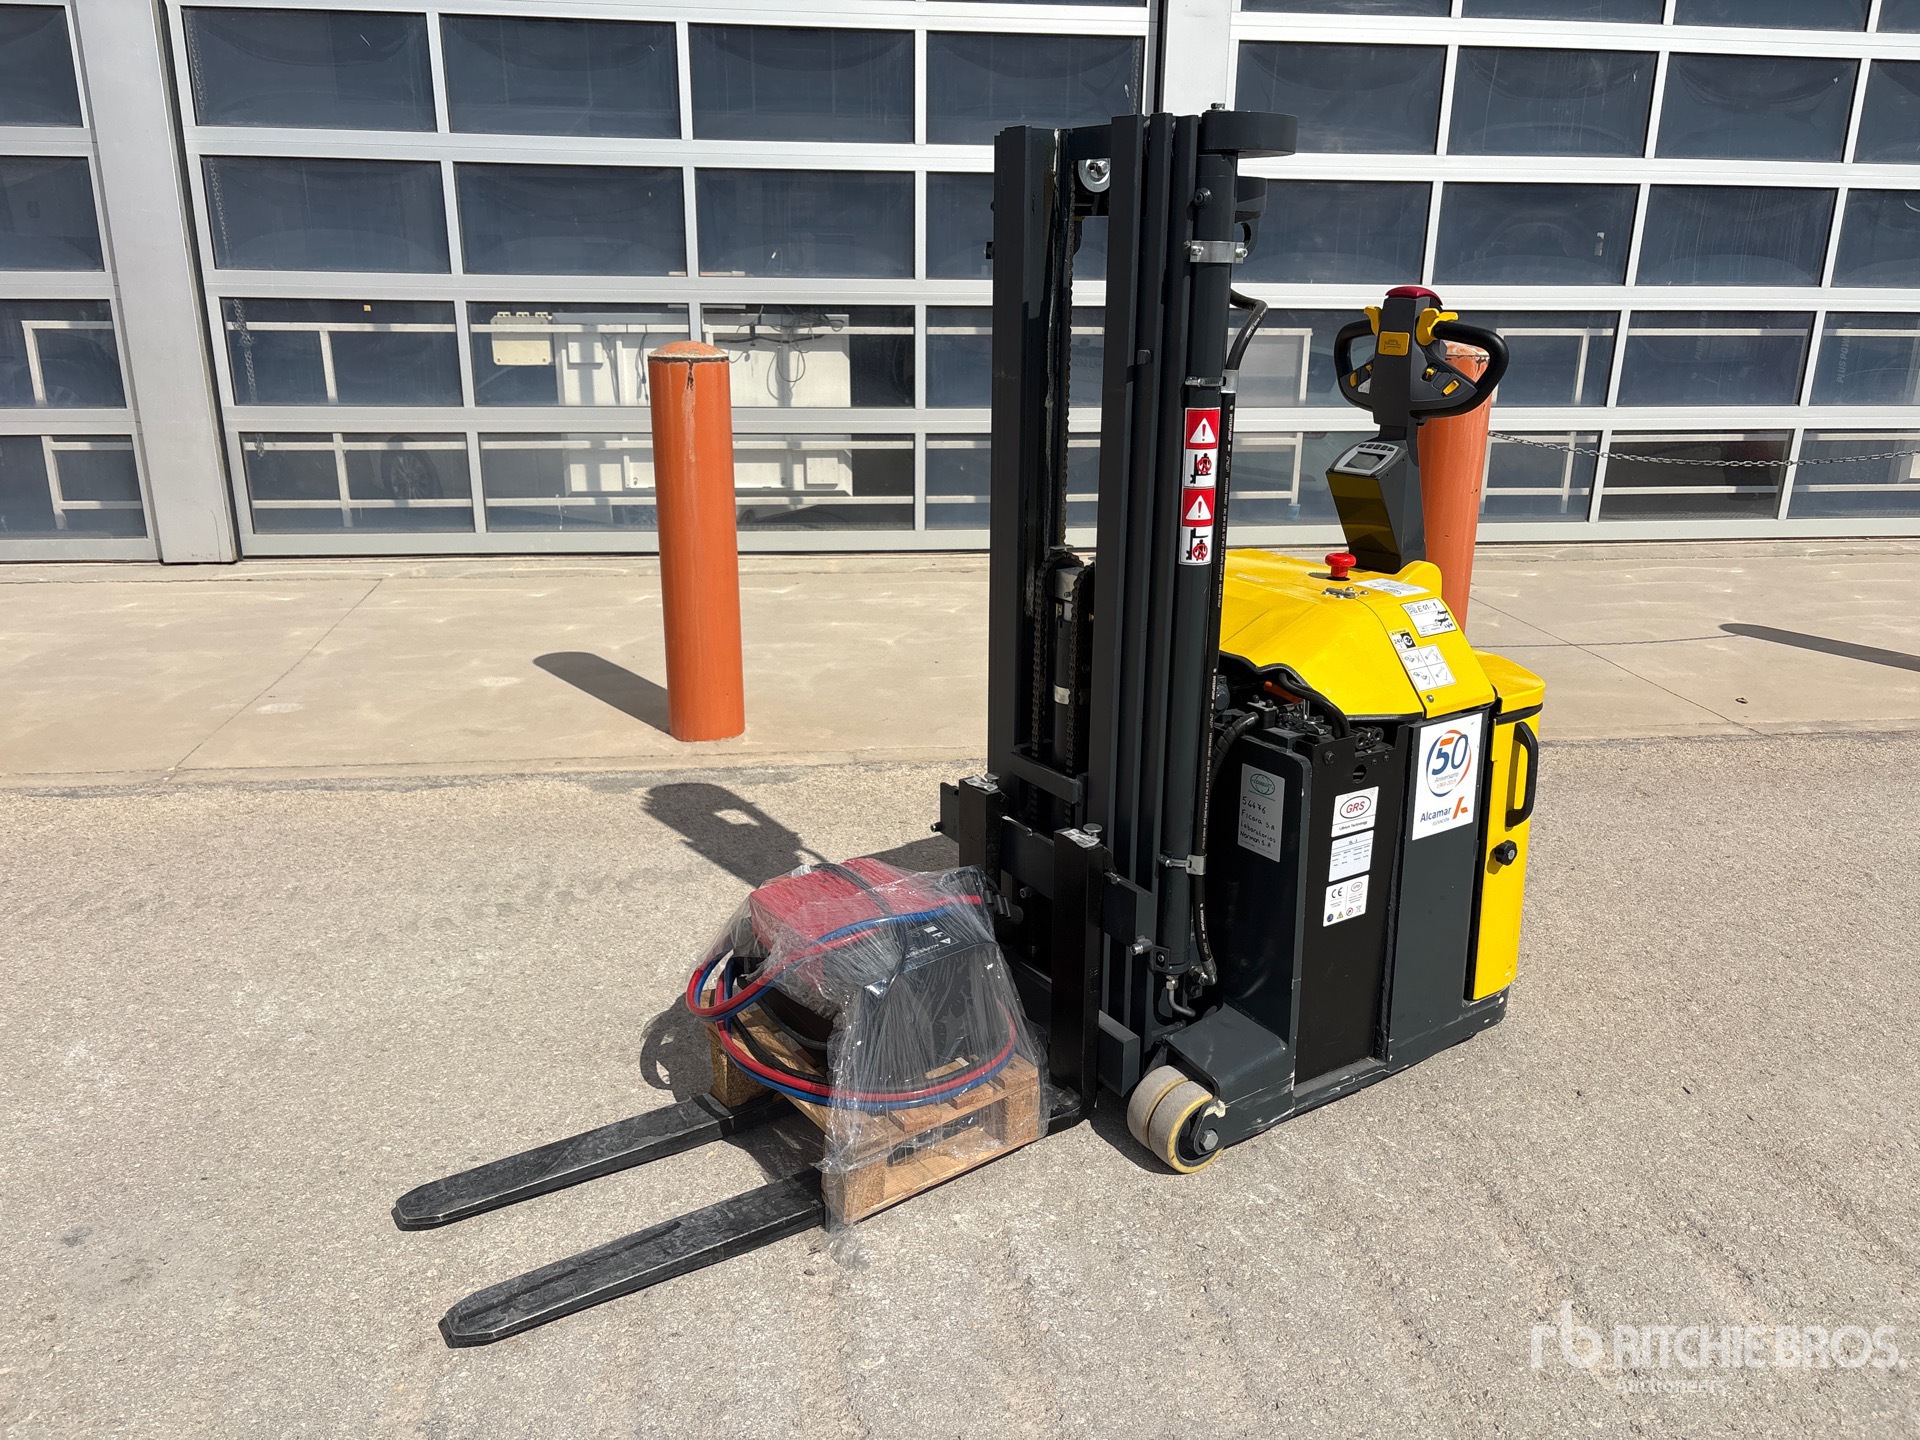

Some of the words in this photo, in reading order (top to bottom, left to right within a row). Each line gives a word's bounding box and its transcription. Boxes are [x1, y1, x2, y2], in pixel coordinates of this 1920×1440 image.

[1836, 360, 1847, 384] PLUS
[1431, 733, 1469, 776] 50
[1346, 801, 1365, 814] GRS
[1420, 806, 1452, 822] Alcamar
